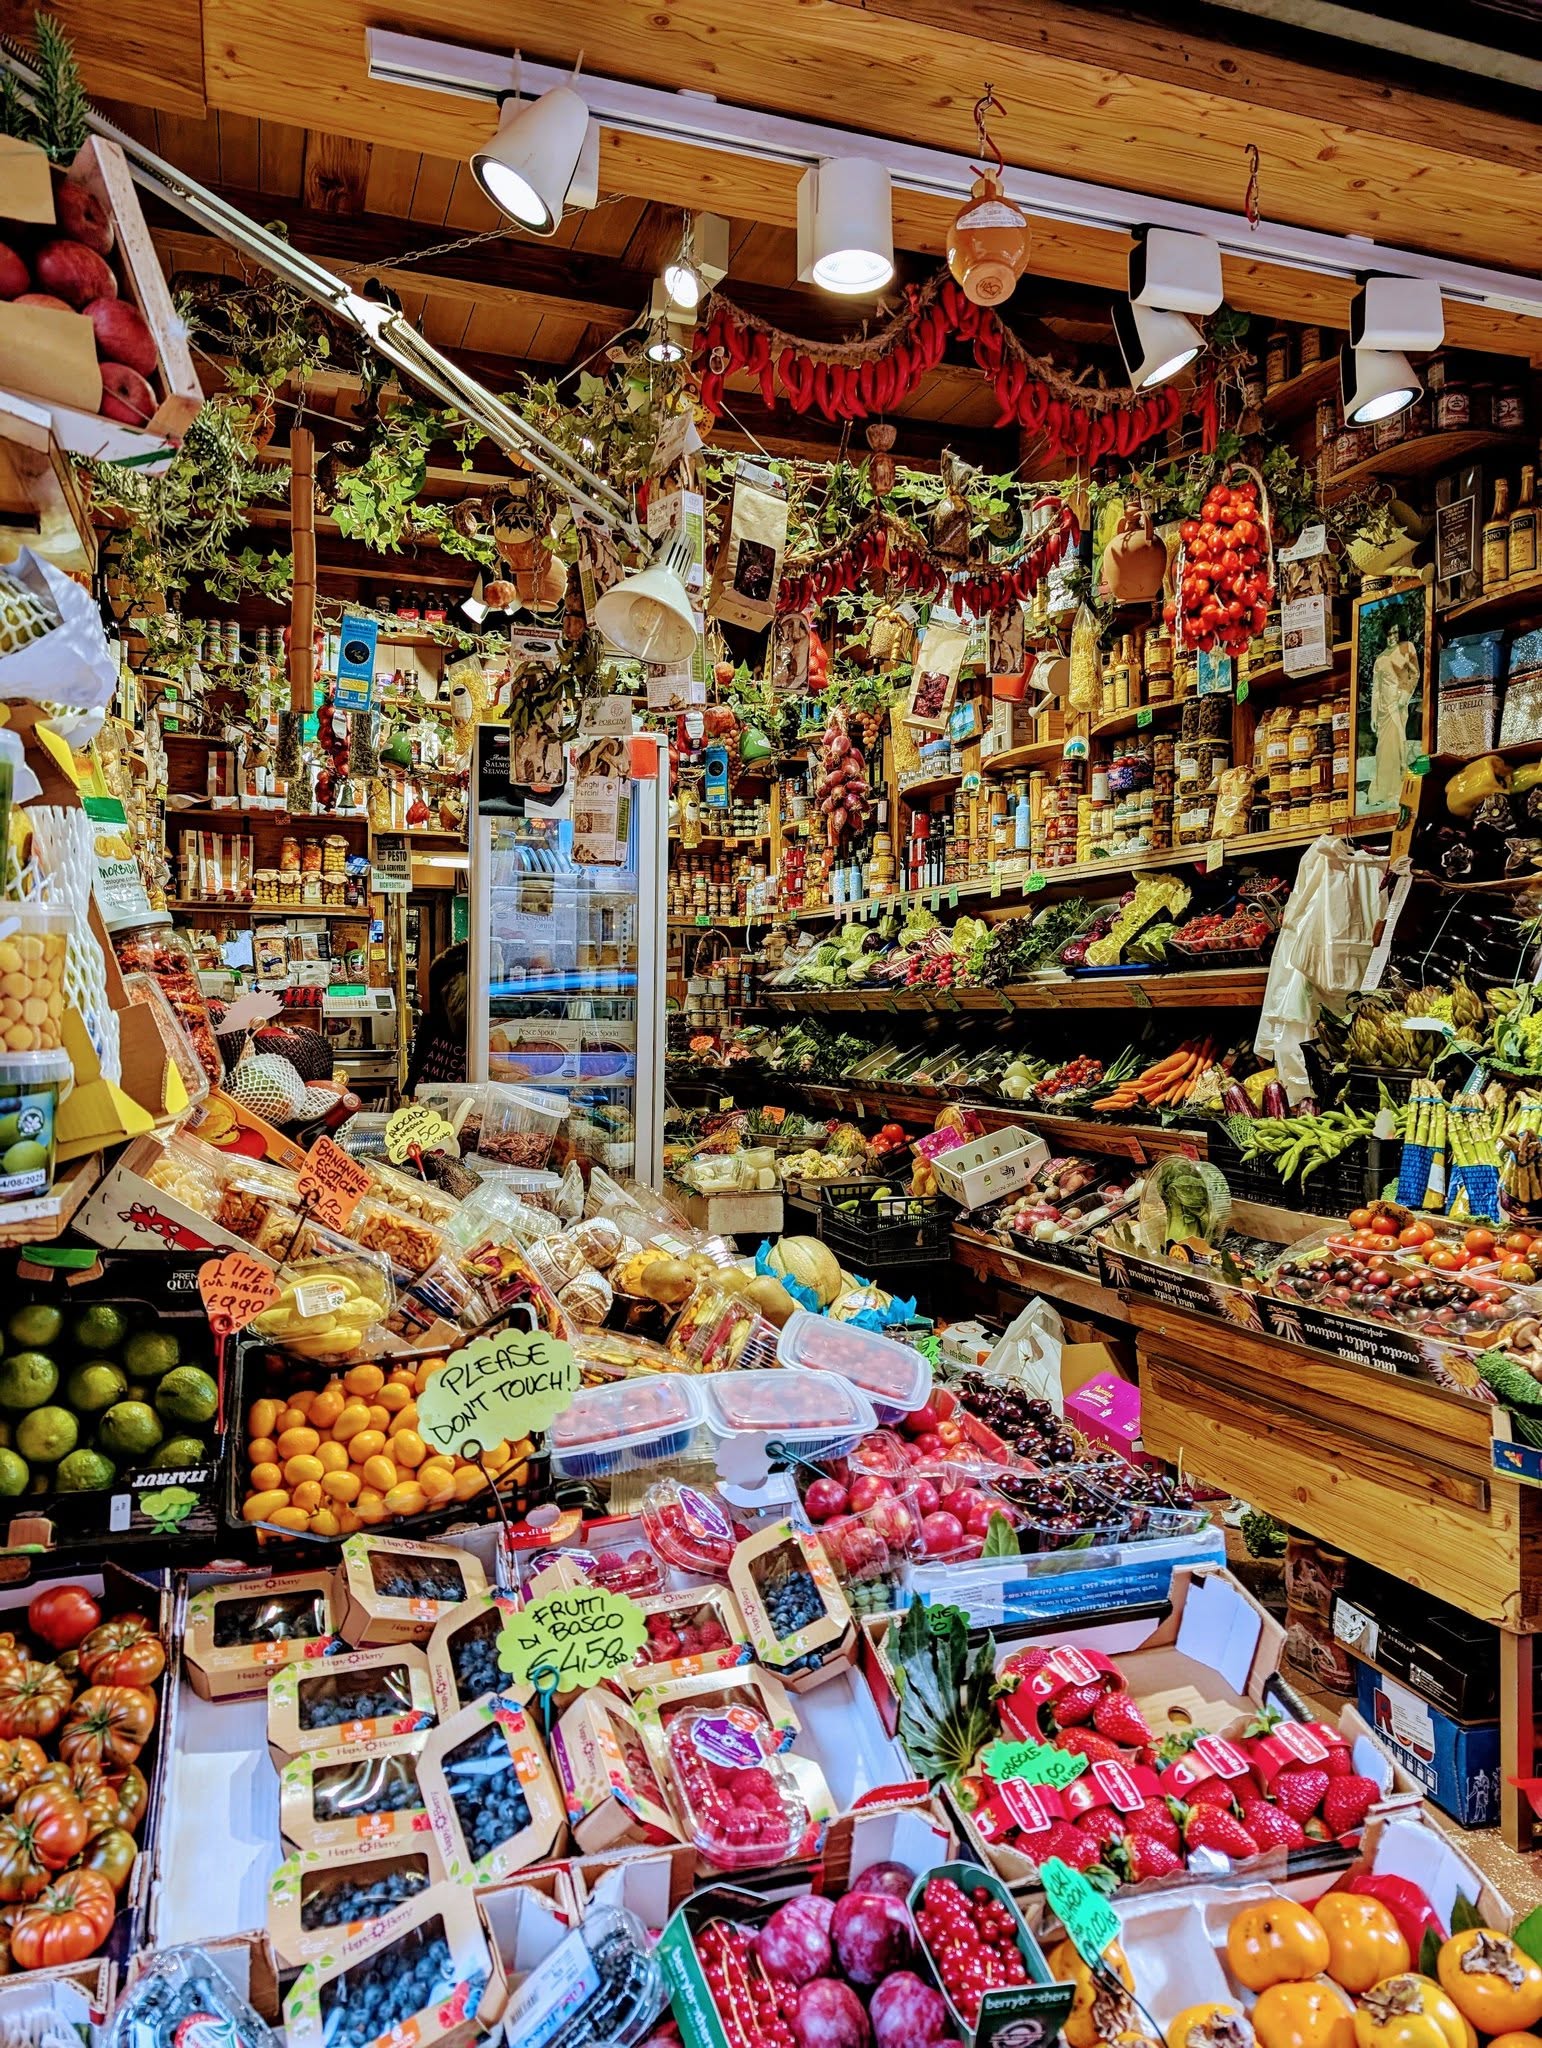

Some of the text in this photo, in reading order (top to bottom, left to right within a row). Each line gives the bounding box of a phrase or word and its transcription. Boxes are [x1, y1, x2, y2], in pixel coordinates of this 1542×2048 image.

[1443, 700, 1484, 712] ACQERELLO
[485, 760, 510, 768] SALMO
[388, 851, 407, 862] PESTO
[518, 1028, 537, 1036] Pesce
[428, 1051, 466, 1072] AMICA
[423, 1063, 463, 1083] AMICA
[389, 1110, 429, 1139] AVOCADO
[316, 1138, 370, 1193] BANANINE
[172, 1271, 199, 1280] PREM
[214, 1259, 267, 1284] LIME
[1128, 1269, 1210, 1303] creata dalla natura
[1177, 1297, 1196, 1310] una
[1303, 1323, 1420, 1365] creata dalla natura
[440, 1342, 549, 1396] PLEASE
[1372, 1357, 1397, 1374] una
[496, 1364, 573, 1403] TOUCH!
[131, 1469, 208, 1488] ITAFRUT
[1135, 1572, 1159, 1582] Phone:
[532, 1596, 604, 1626] FRUTTI
[518, 1613, 624, 1649] DI BOSCO
